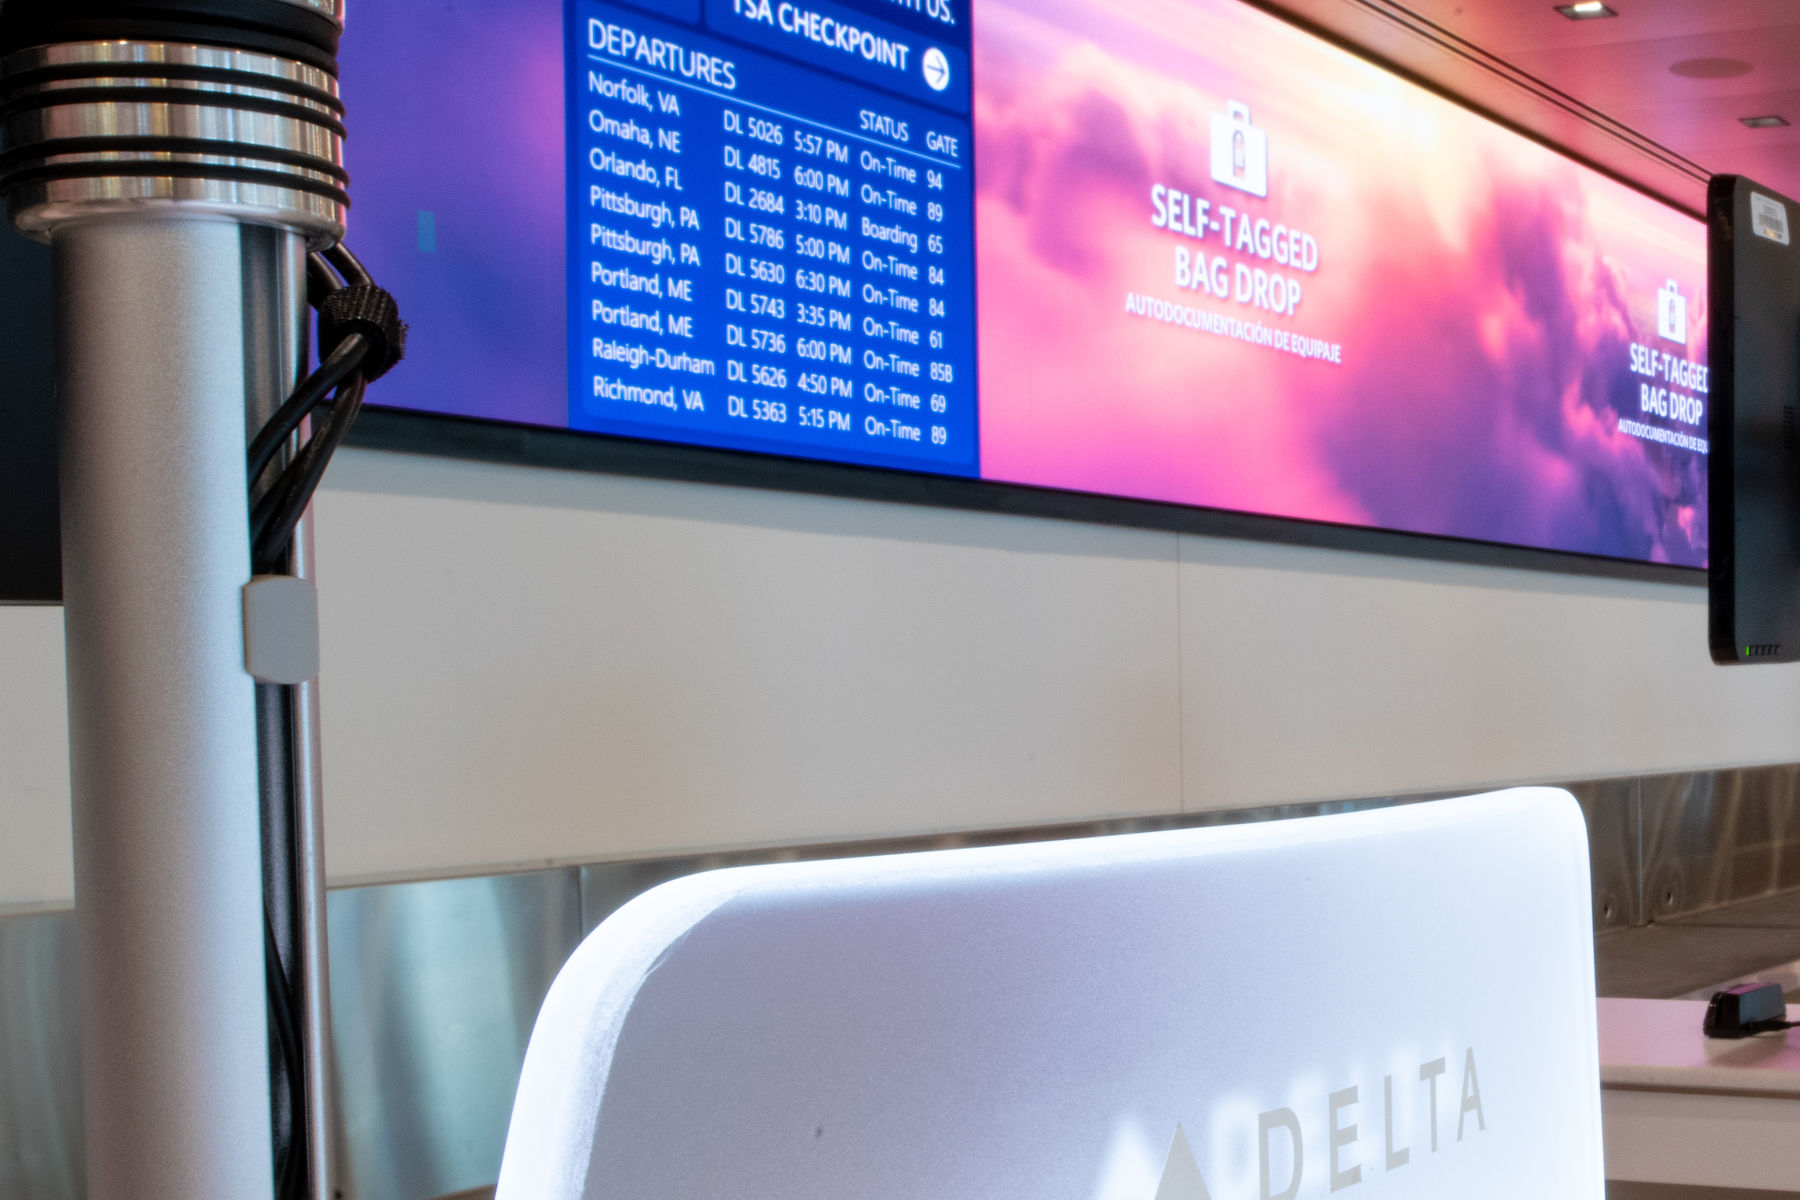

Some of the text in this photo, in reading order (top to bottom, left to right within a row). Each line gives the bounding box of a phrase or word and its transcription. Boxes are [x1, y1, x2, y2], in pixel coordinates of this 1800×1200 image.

[588, 17, 736, 90] DEPARTURES
[777, 2, 909, 70] CHECKPOINT
[588, 70, 943, 190] Norfolk, VA DL 5026 5:57 PM On-Time 94
[588, 109, 943, 222] Omaha, NE DL 4815 6:00 PM On-Time 89
[859, 109, 958, 157] STATUS GATE
[589, 147, 943, 254] Orlando, FL DL 2684 3:10 PM Boarding 65
[590, 184, 945, 286] Pittsburgh, PA DL 5786 5:00 PM On-Time 84
[1151, 183, 1318, 272] SELF-TAGGED
[590, 223, 945, 317] Pittsburgh, PA DL 5630 6:30 PM On-Time 84
[591, 261, 943, 349] Portland, ME DL 5743 3:35 PM On-Time 61
[1175, 245, 1301, 316] BAG DROP
[591, 299, 953, 383] Portland, ME DL 5736 6:00 PM On-Time 85B
[1126, 292, 1341, 363] AUTODOCUMENTACIÓN DE EQUIPAJE
[592, 337, 947, 414] Raleigh-Durham DL 5626 4:50 PM On-Time 69
[593, 375, 947, 446] Richmond, VA DL 5363 5:15 PM On-Time 89
[1641, 383, 1703, 426] BAG DROP
